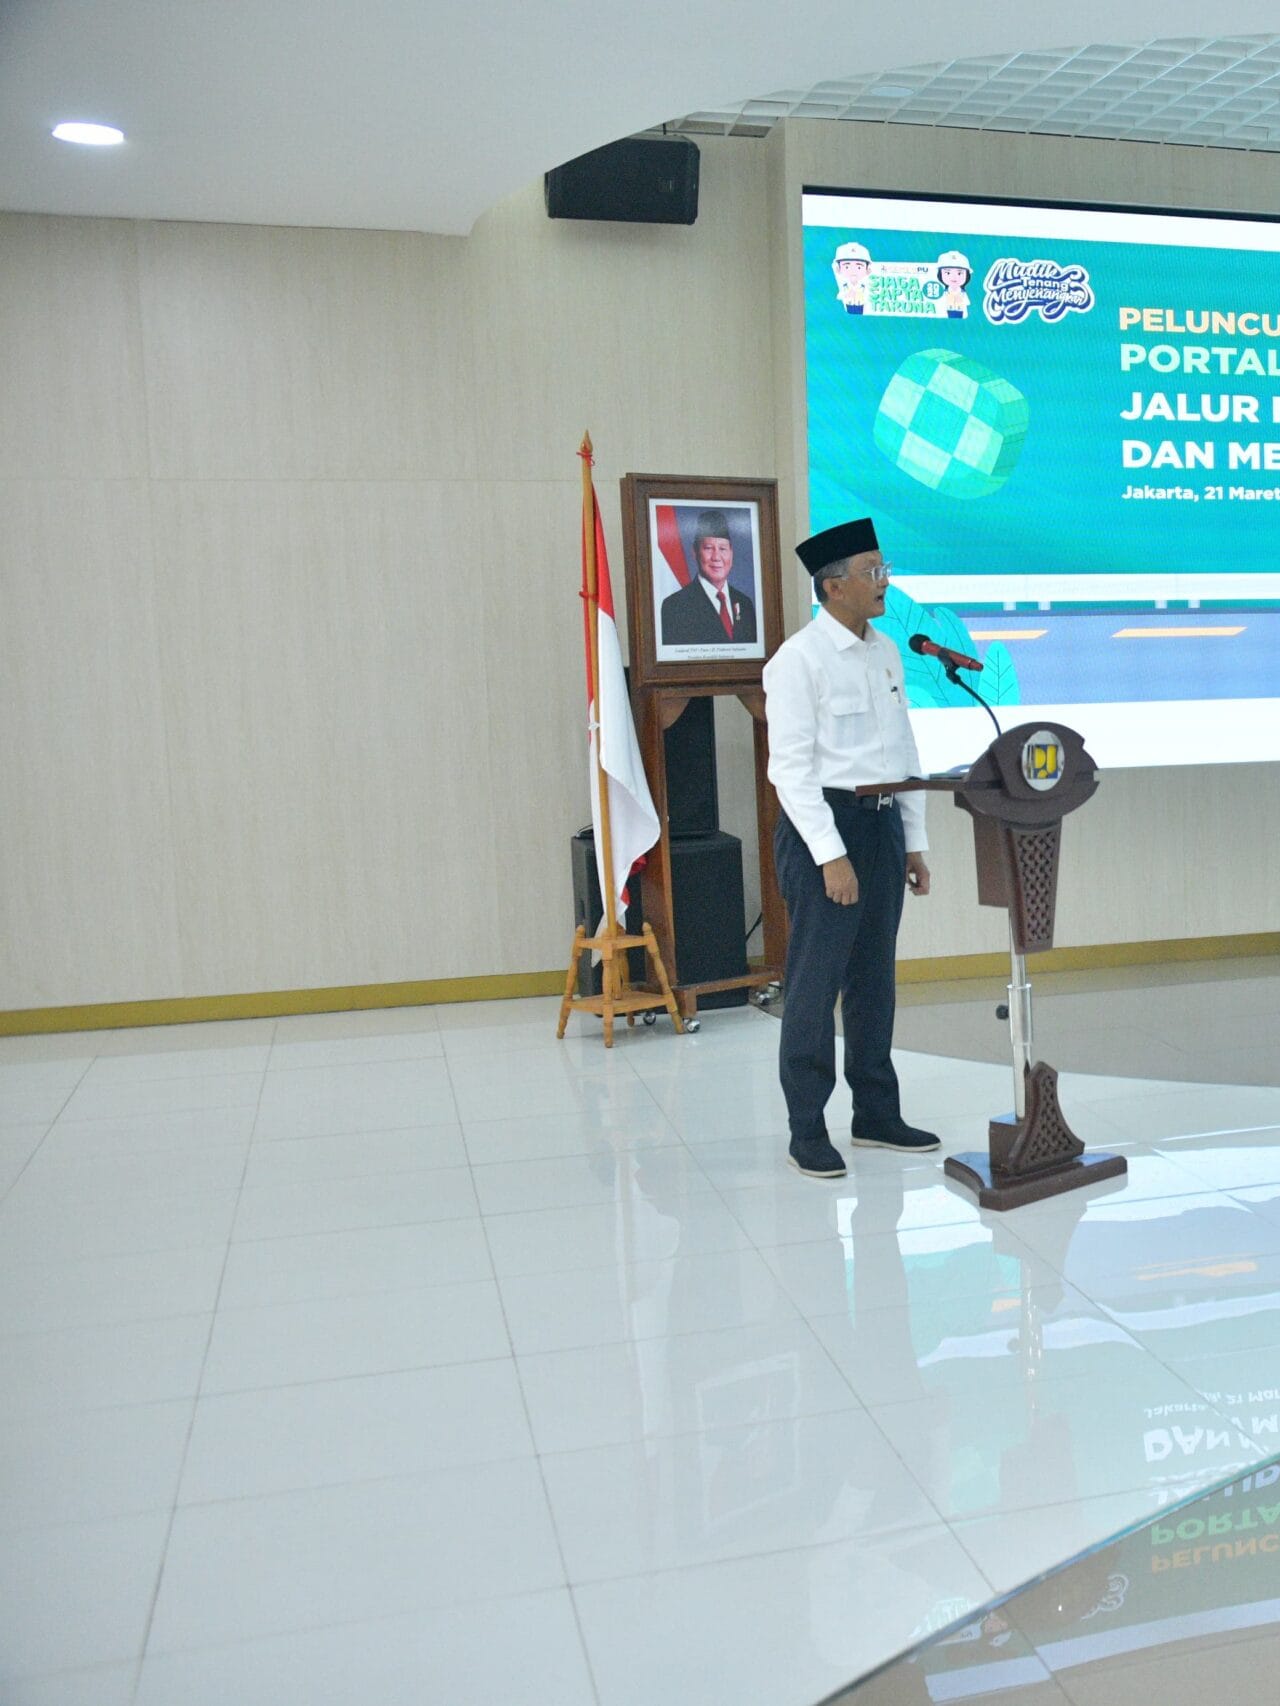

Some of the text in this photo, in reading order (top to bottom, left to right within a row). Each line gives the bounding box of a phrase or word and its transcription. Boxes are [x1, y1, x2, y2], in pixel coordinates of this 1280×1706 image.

[1021, 277, 1069, 292] Tenang
[1119, 391, 1260, 424] JALUR
[1122, 439, 1215, 469] DAN
[1121, 485, 1199, 502] Jakarta,
[1203, 486, 1224, 500] 21
